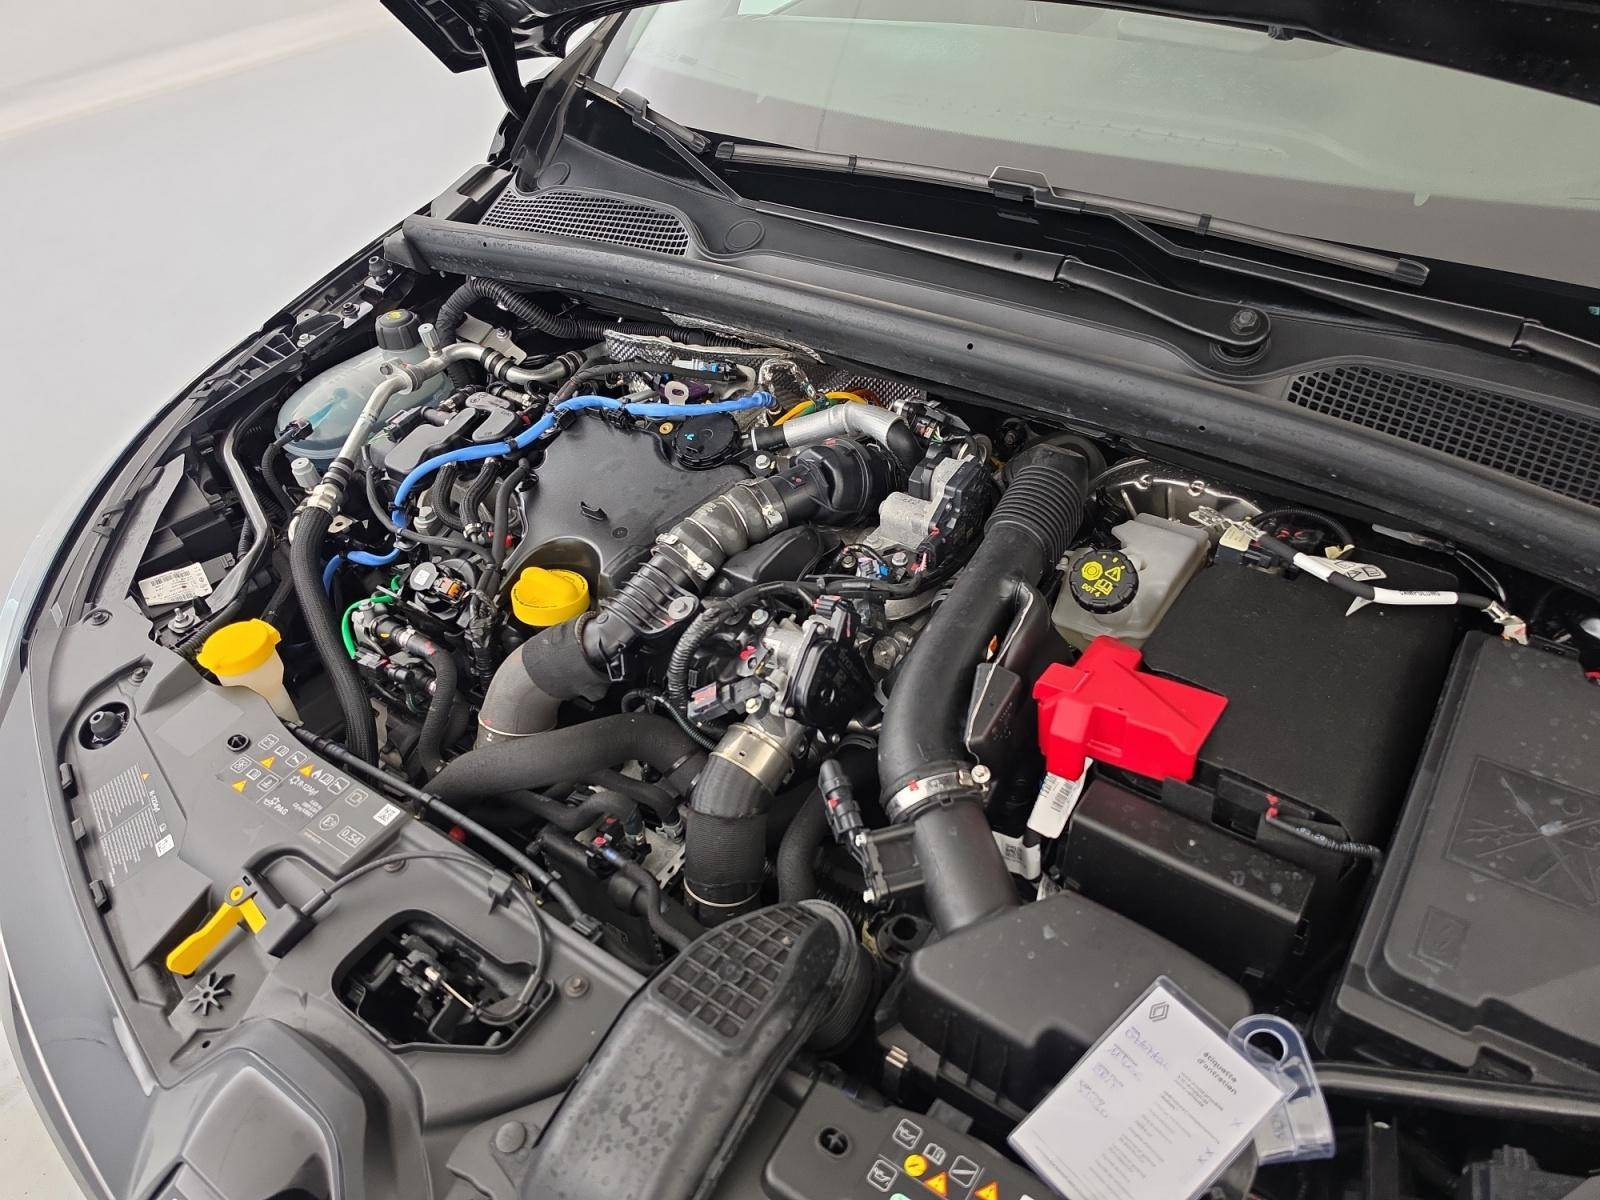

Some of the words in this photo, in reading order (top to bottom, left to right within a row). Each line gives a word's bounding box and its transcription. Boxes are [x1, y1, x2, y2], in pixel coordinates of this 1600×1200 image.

[1081, 583, 1096, 594] DOT
[274, 804, 289, 816] PAG
[341, 829, 361, 844] 0,54
